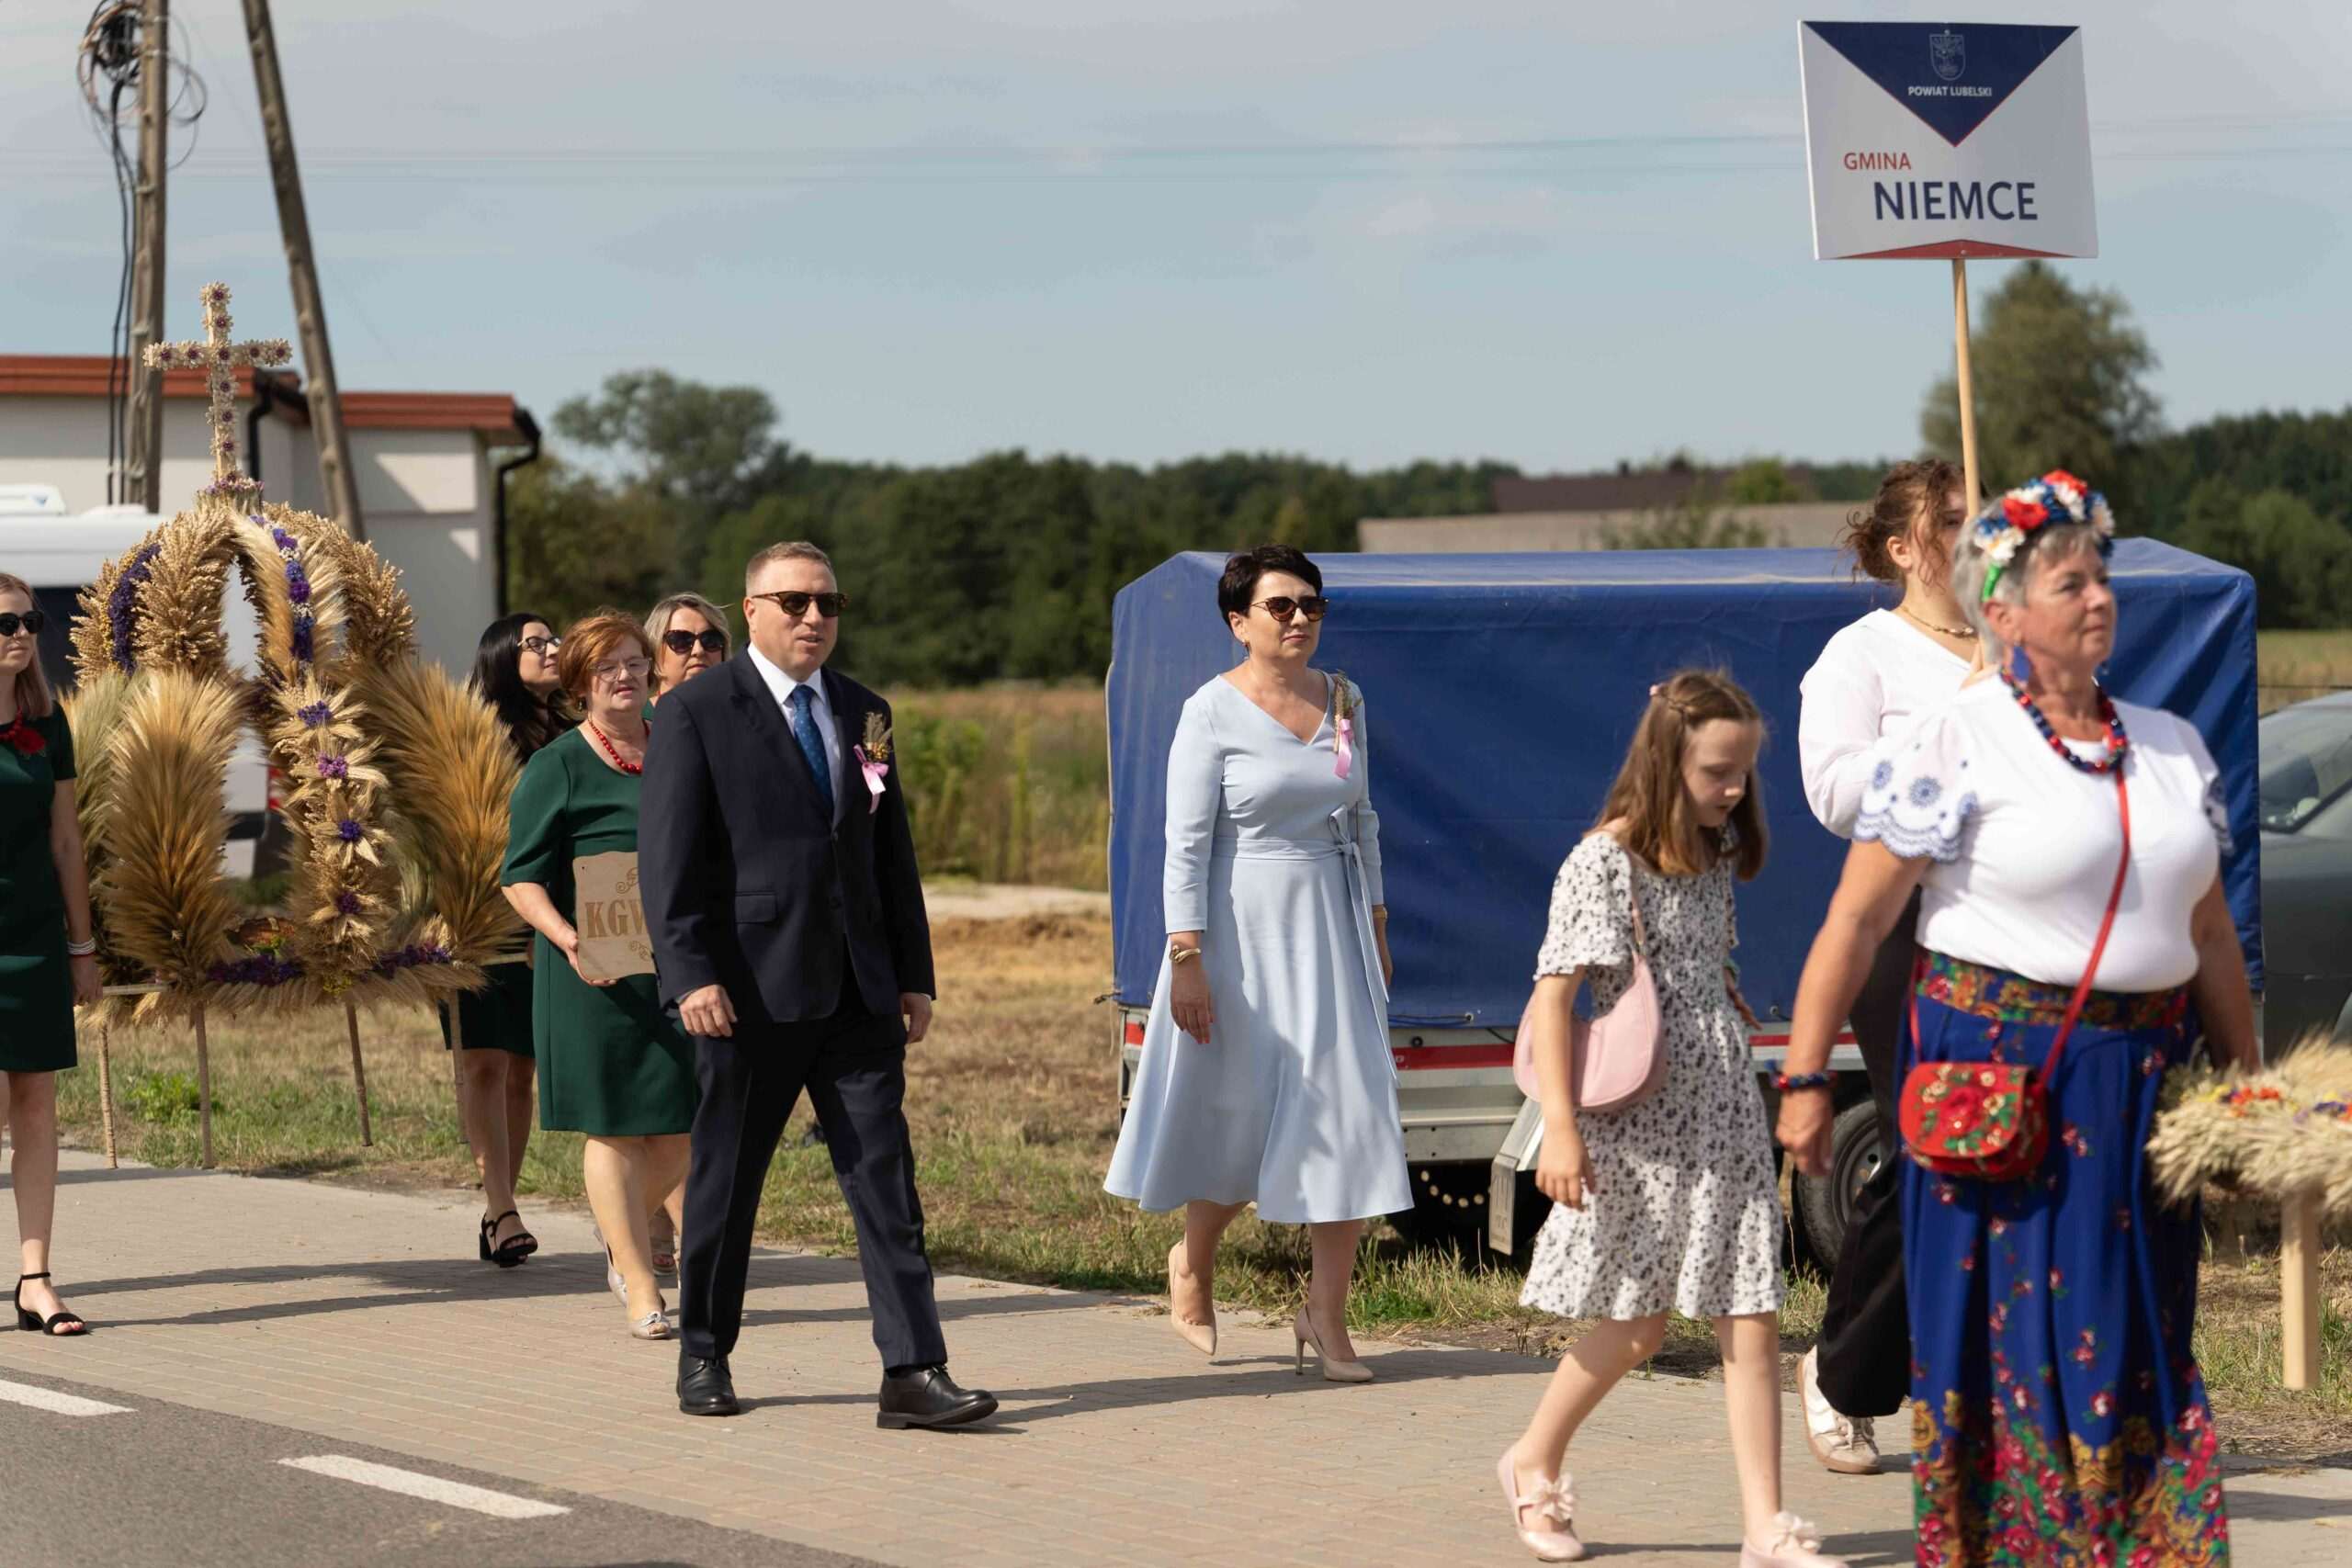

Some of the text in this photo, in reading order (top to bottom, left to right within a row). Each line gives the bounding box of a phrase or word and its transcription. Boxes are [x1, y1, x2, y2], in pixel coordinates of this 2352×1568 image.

[1908, 86, 1992, 96] POWIAT LUBELSKI
[1844, 152, 1912, 170] GMINA
[1874, 182, 2039, 220] NIEMCE
